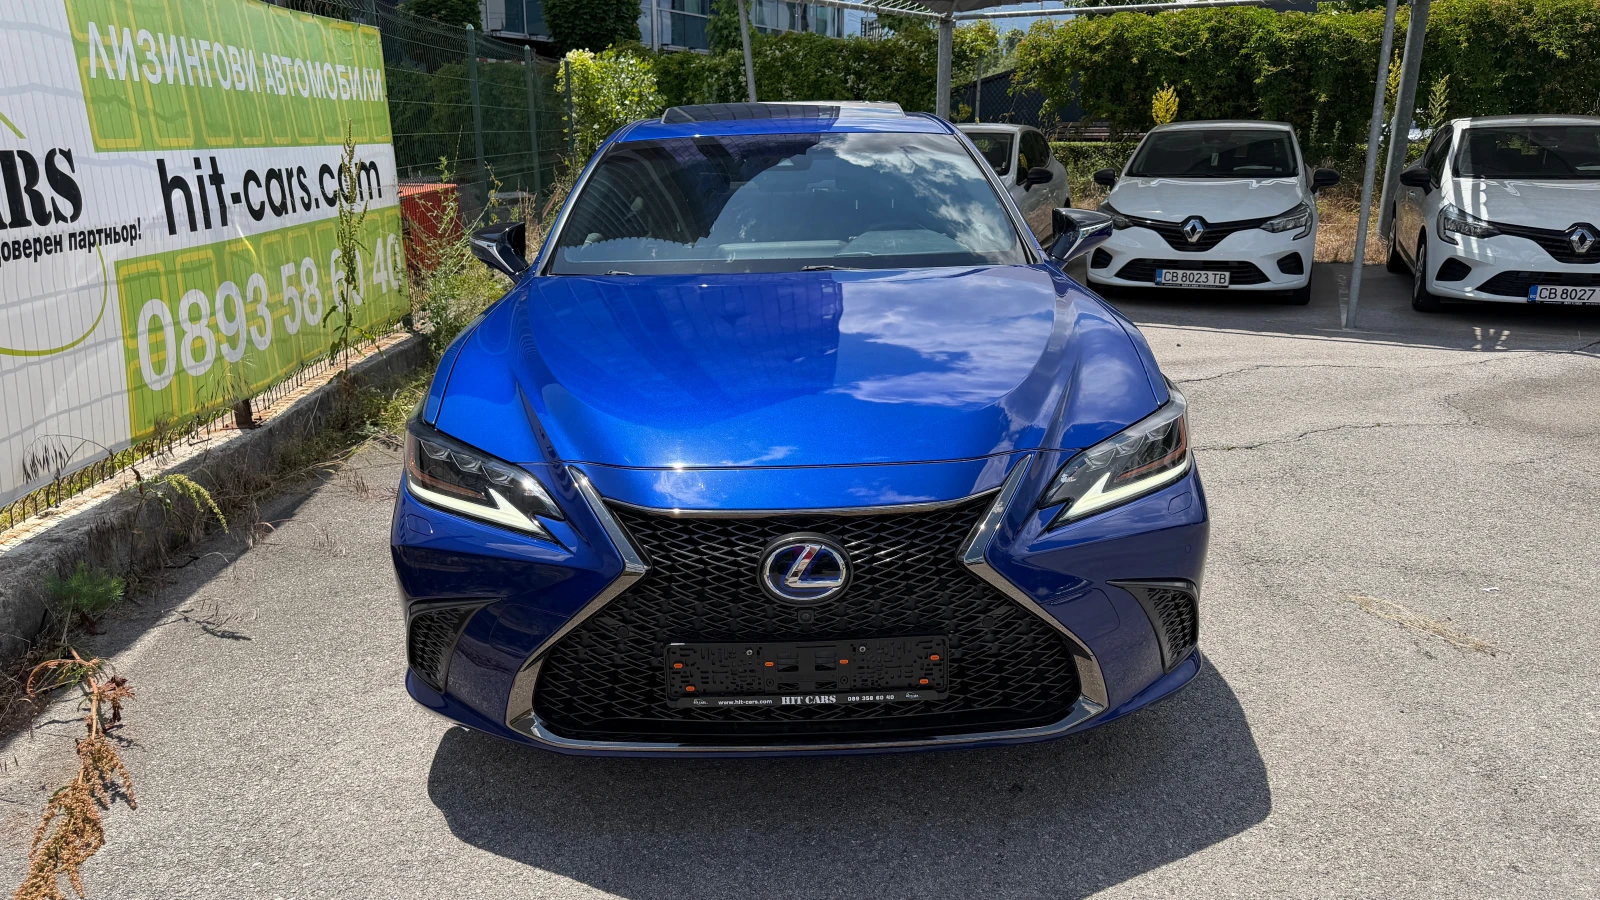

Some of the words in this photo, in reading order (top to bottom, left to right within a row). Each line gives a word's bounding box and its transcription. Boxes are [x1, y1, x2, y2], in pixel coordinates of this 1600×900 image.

[88, 21, 261, 93] ЛИЗИНГОВИ
[262, 52, 384, 102] АВТОМОБИЛИ
[0, 147, 83, 231] RS
[0, 235, 64, 268] оверен
[68, 216, 142, 254] партньор!
[1163, 271, 1179, 283] CB
[1181, 272, 1209, 284] 8023
[1212, 273, 1227, 284] TB
[1539, 287, 1558, 300] CB
[1560, 288, 1596, 300] 8027
[137, 272, 272, 391] 0893
[280, 256, 323, 335] 58
[373, 233, 402, 294] 40
[781, 696, 803, 704] HIT
[805, 695, 836, 704] CARS
